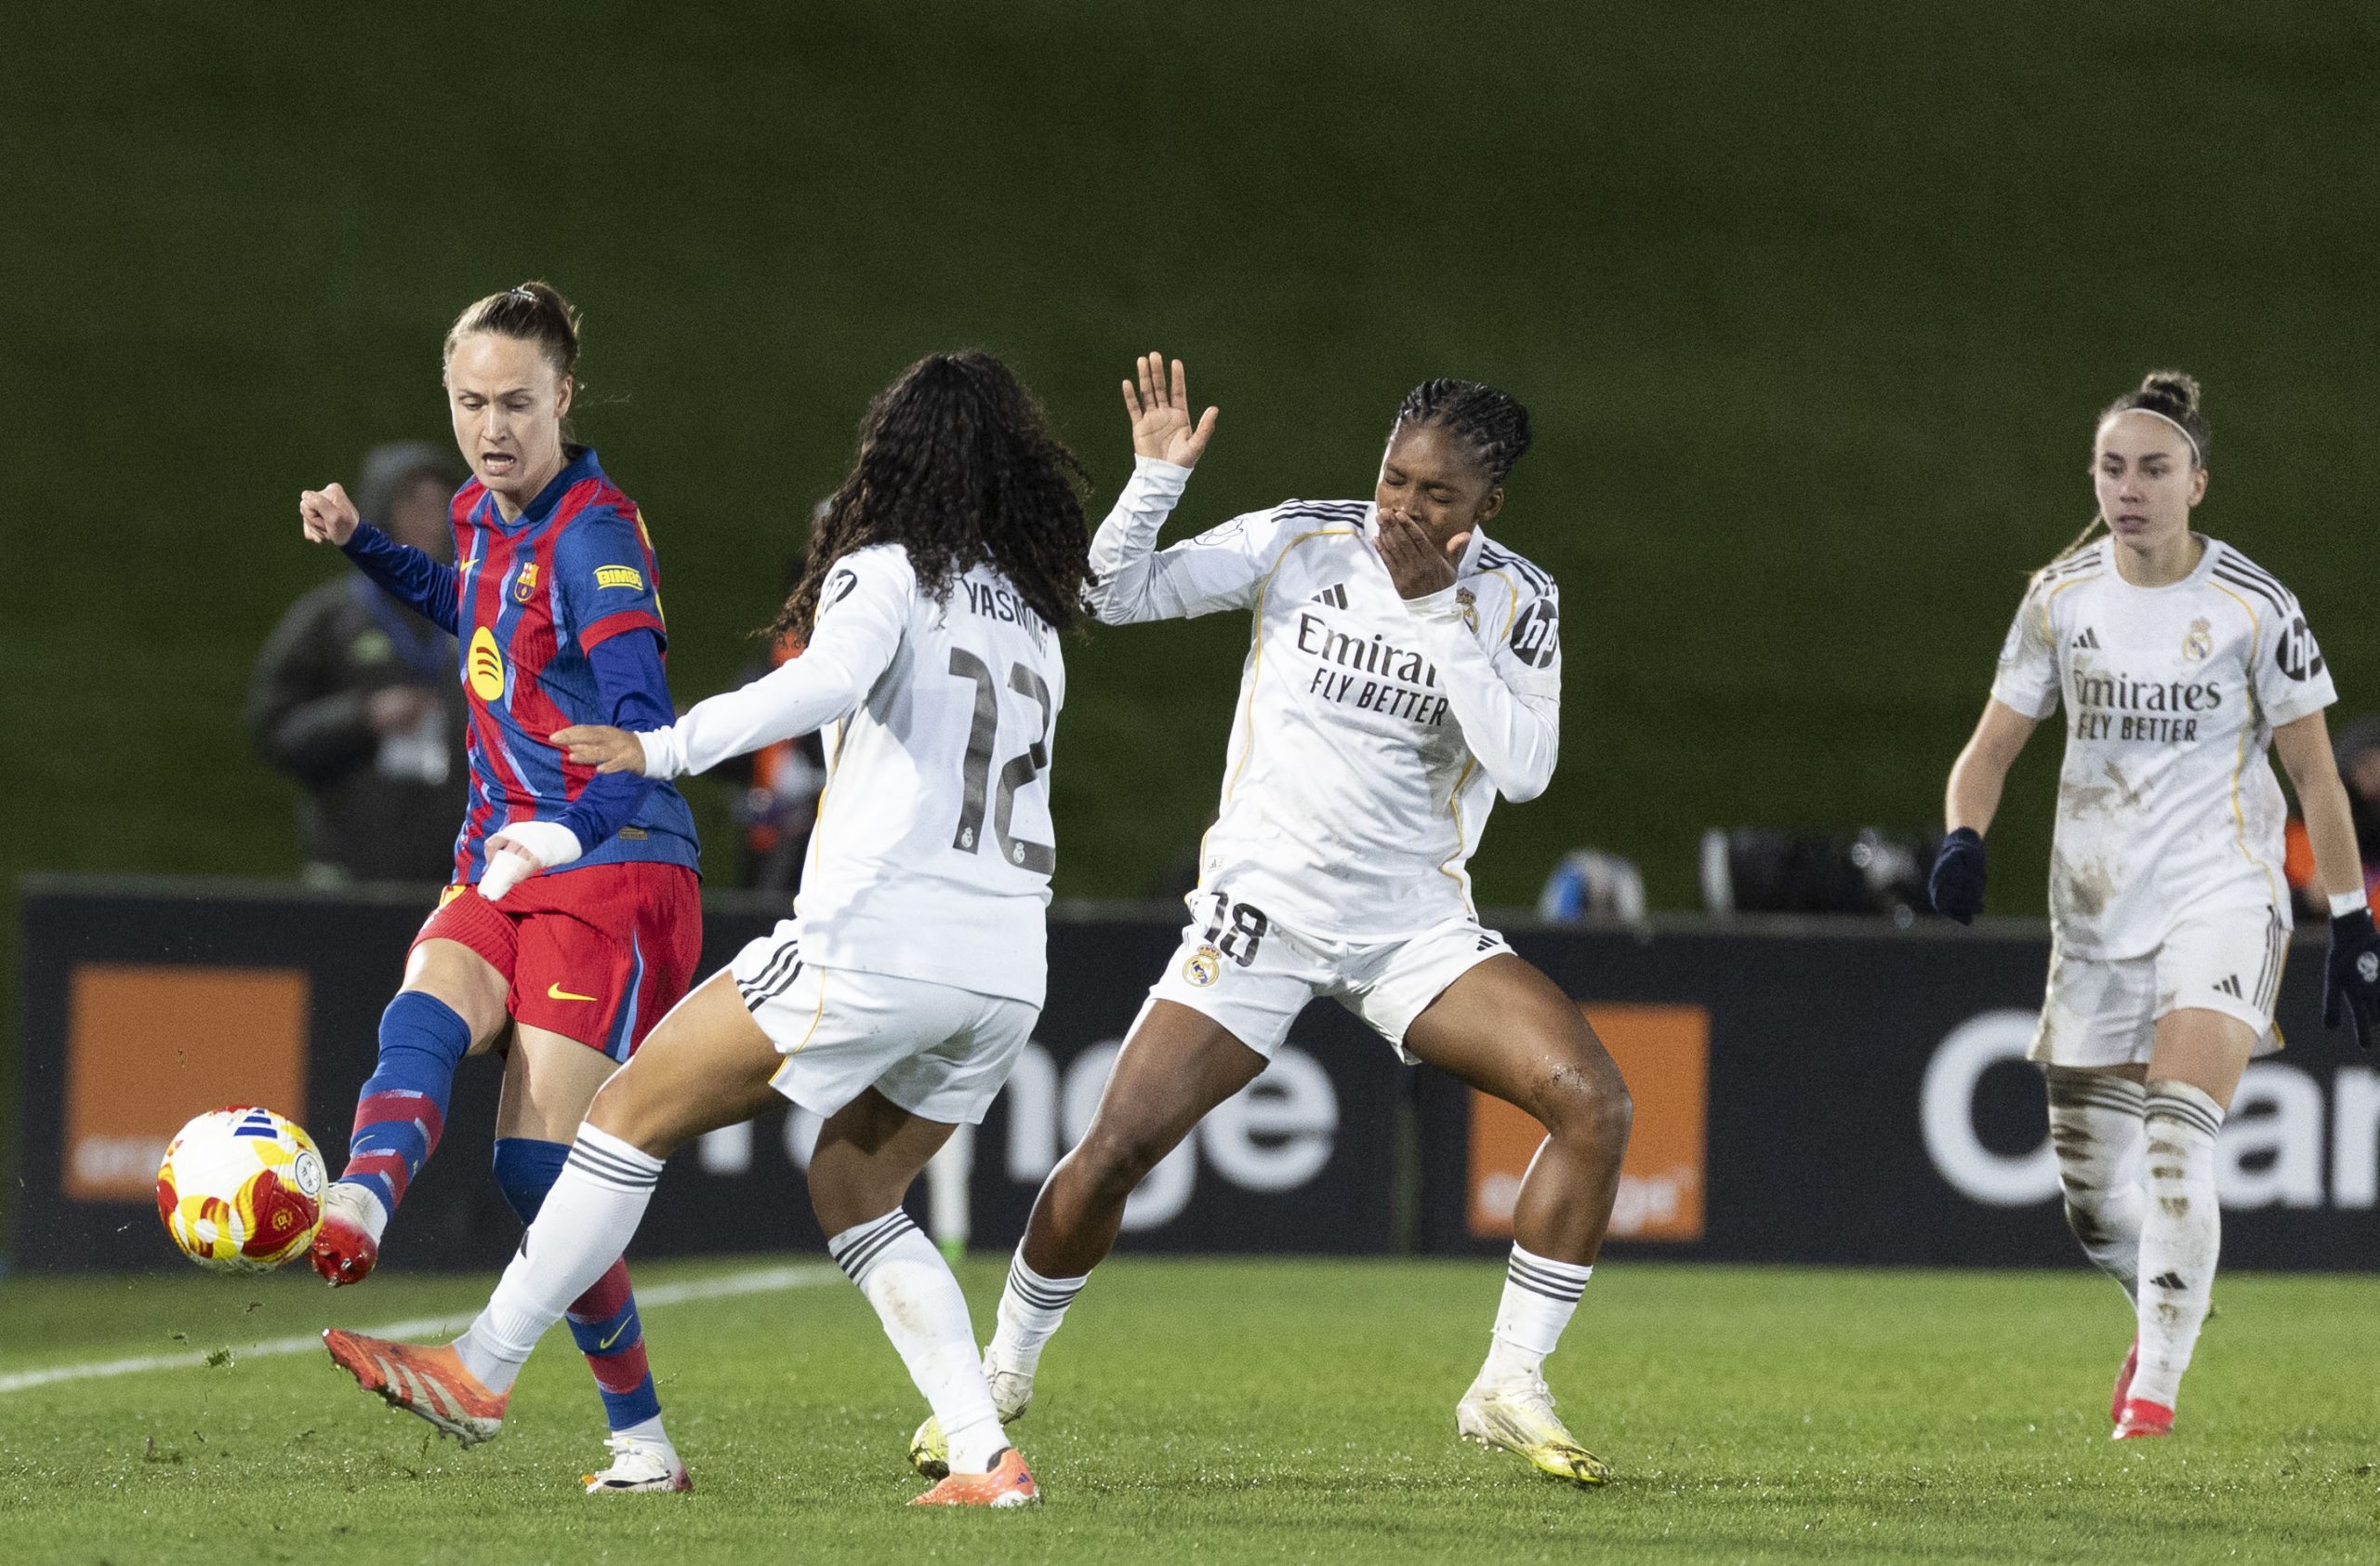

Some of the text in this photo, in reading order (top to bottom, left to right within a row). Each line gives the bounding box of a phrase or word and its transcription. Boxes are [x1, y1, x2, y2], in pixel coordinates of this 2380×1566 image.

[1298, 612, 1437, 688] Emira
[1511, 595, 1559, 670] hp
[1310, 667, 1449, 726] FLY BETTER
[2077, 710, 2198, 742] FLY BETTER
[948, 646, 1056, 875] 12
[1204, 891, 1268, 968] 18
